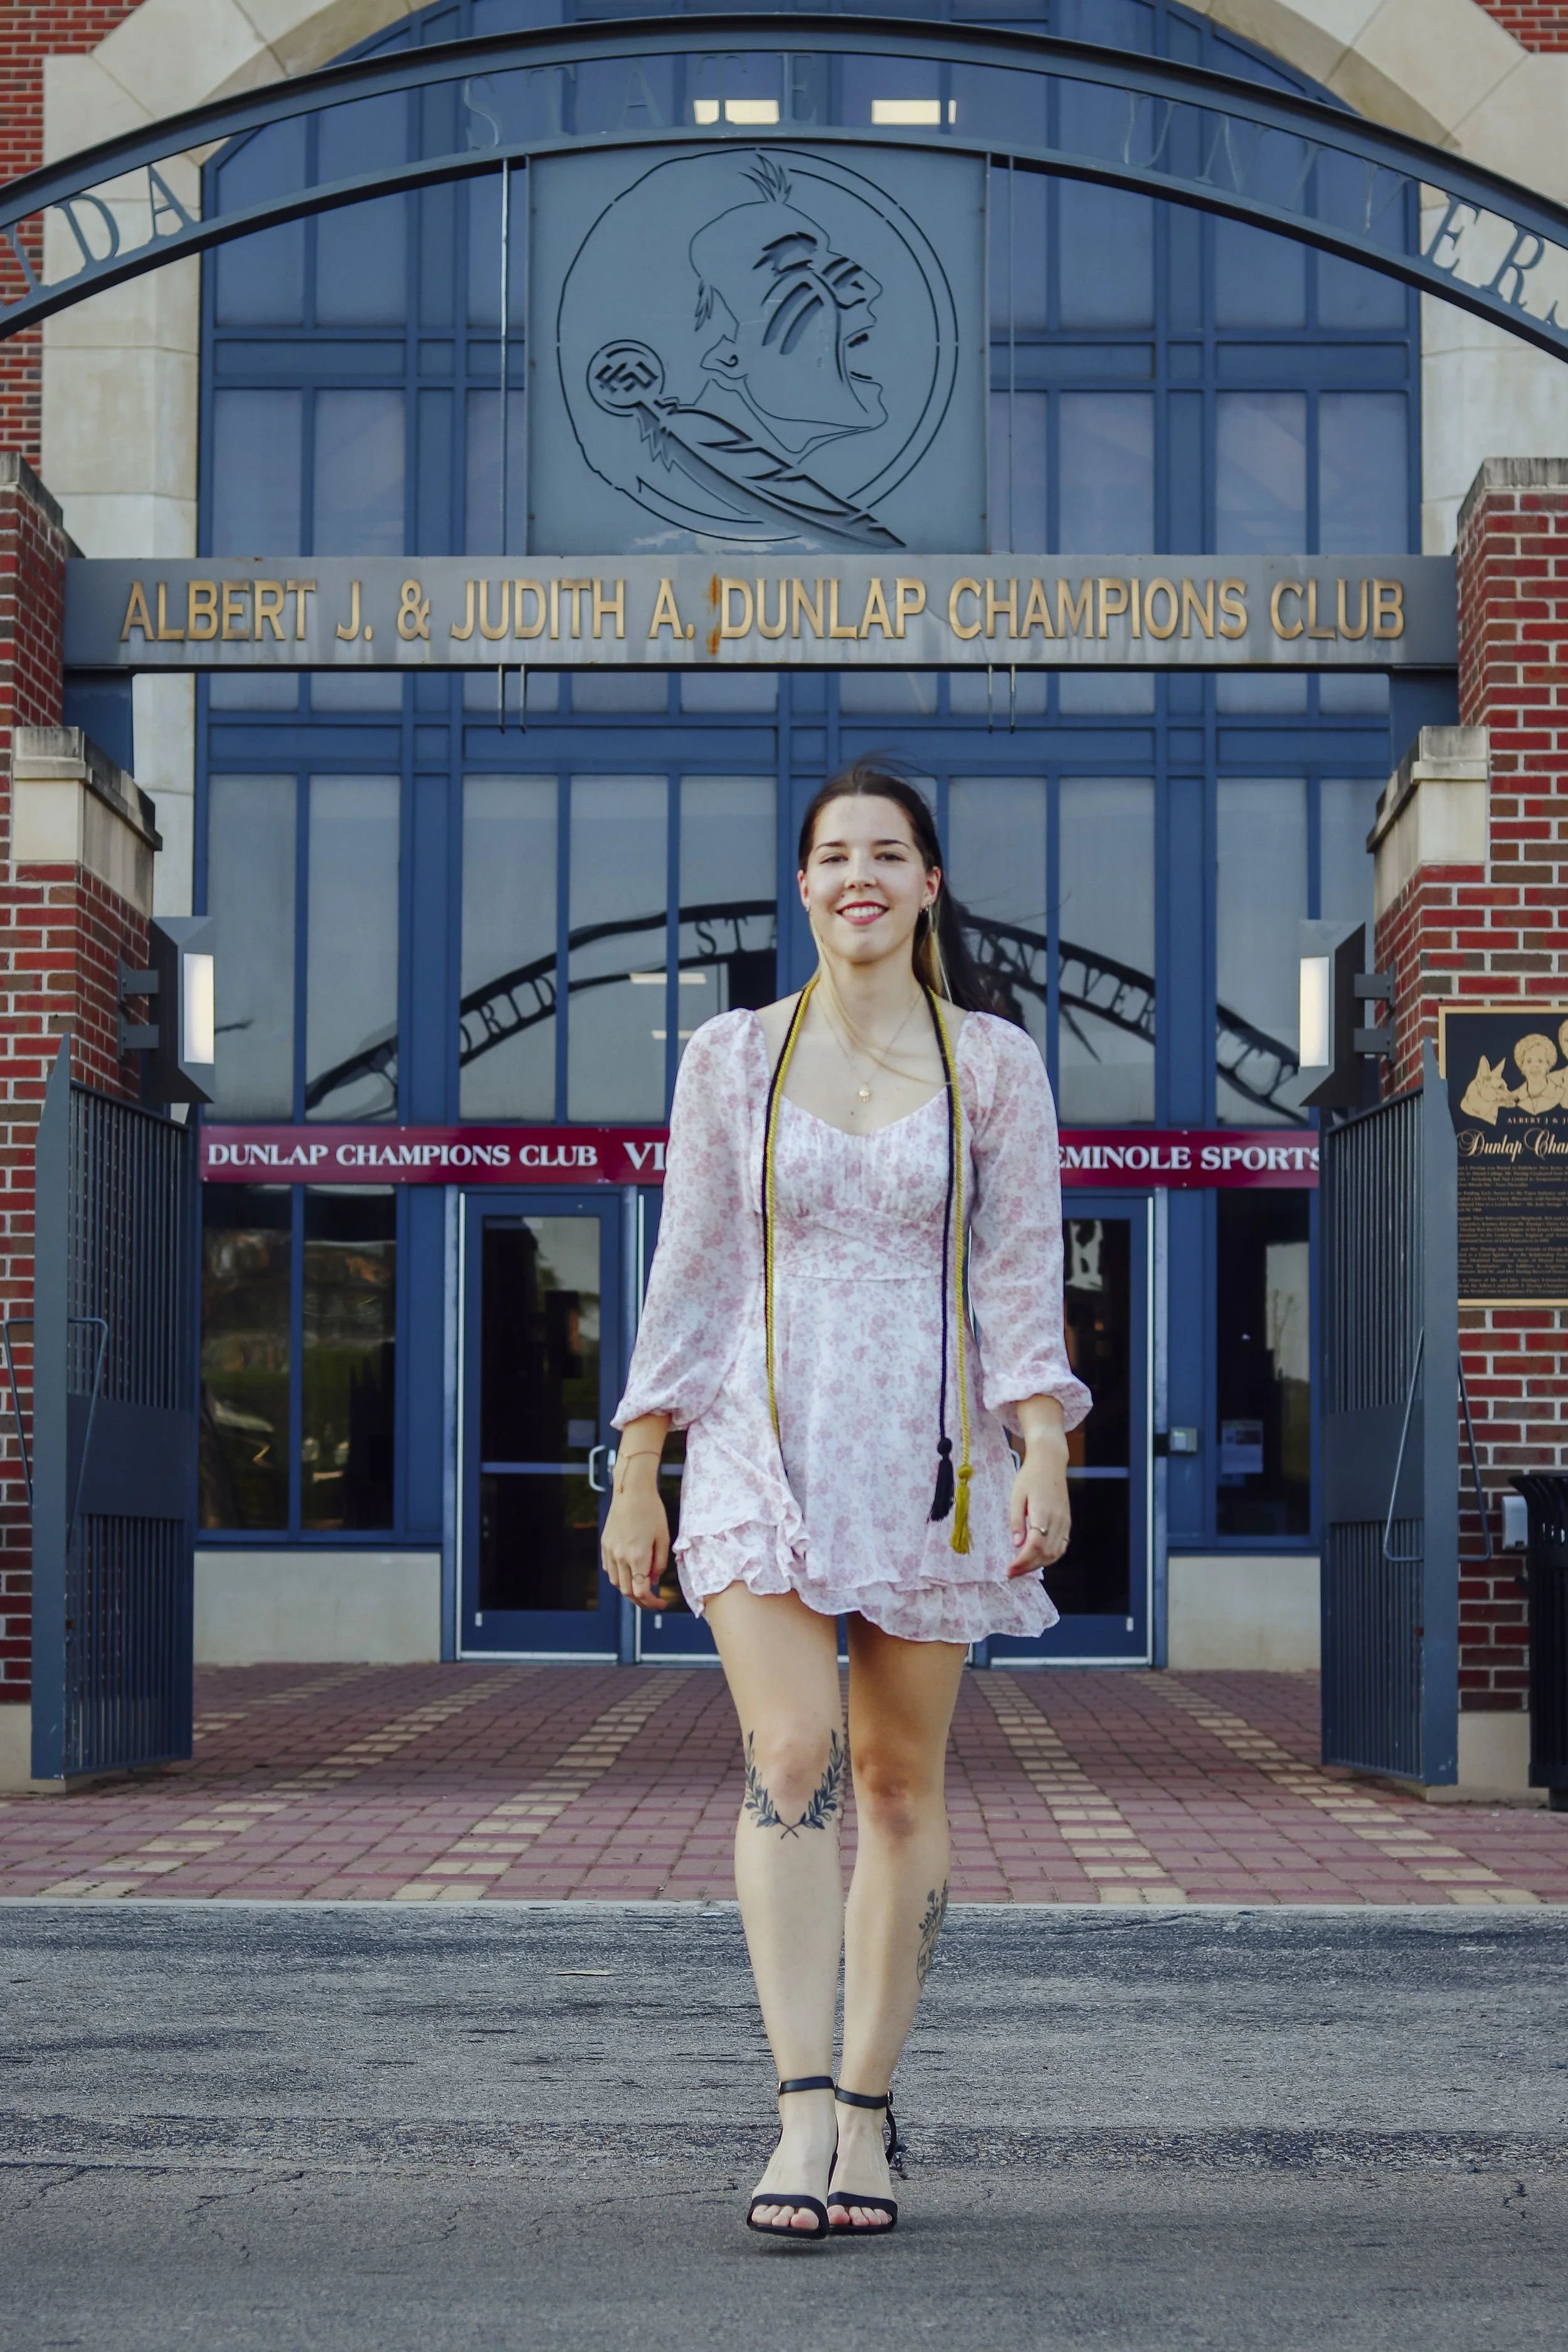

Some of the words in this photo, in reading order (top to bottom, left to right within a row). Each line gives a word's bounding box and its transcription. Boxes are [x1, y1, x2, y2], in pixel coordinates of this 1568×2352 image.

[462, 53, 819, 151] STATE
[120, 580, 316, 641] ALBERT
[337, 580, 373, 641] J.
[397, 579, 430, 641] &
[451, 578, 625, 640] JUDITH
[649, 578, 695, 640] A.
[720, 578, 926, 640] DUNLAP
[948, 577, 1247, 640] CHAMPIONS
[1270, 578, 1405, 640] CLUB
[208, 1143, 329, 1165] DUNLAP
[336, 1144, 511, 1166] CHAMPIONS
[519, 1145, 598, 1167] CLUB
[1456, 1128, 1524, 1163] Dunlap
